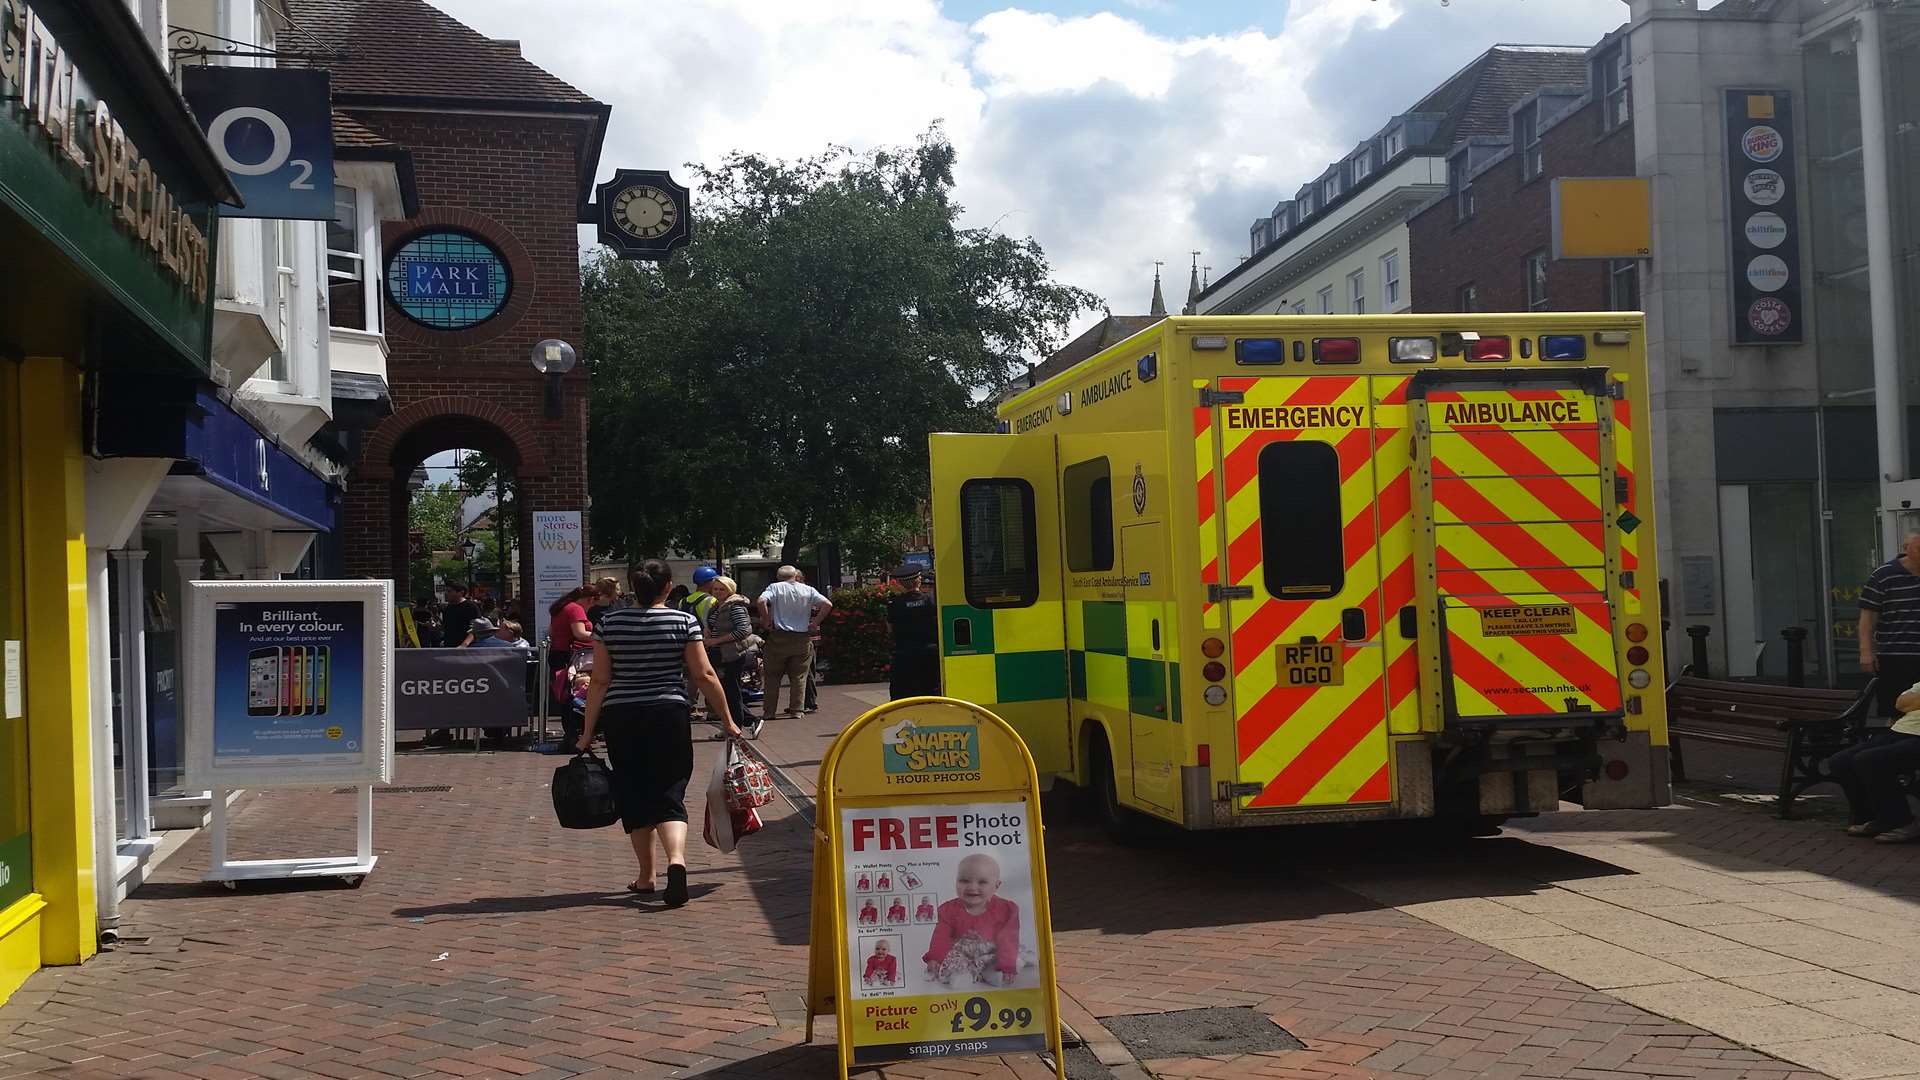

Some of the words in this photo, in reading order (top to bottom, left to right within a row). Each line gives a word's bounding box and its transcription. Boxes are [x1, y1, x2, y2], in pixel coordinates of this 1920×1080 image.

[1748, 138, 1778, 153] KING
[94, 99, 209, 304] SPECIALISTS
[415, 265, 480, 281] PARK
[414, 281, 484, 296] MALL
[1016, 404, 1054, 433] EMERGENCY
[1080, 369, 1132, 408] AMBULANCE
[1227, 406, 1365, 429] EMERGENCY
[1444, 401, 1582, 424] AMBULANCE
[543, 520, 579, 530] stores
[537, 529, 564, 541] this
[538, 540, 579, 554] way
[262, 610, 322, 621] Brilliant.
[1483, 608, 1521, 619] KEEP
[1523, 607, 1571, 617] CLEAR
[240, 621, 253, 632] In
[256, 623, 296, 635] every
[299, 621, 344, 632] colour.
[400, 677, 490, 696] GREGGS
[1483, 684, 1592, 695] www.secamb.nhs.uk
[895, 729, 972, 756] SNAPPY
[906, 751, 970, 771] SNAPS
[886, 775, 891, 784] 1
[895, 774, 931, 784] HOUR
[934, 772, 981, 783] PHOTOS
[963, 813, 1021, 830] Photo
[852, 816, 959, 852] FREE
[964, 830, 1022, 847] Shoot
[865, 1005, 918, 1018] Picture
[929, 999, 960, 1015] Only
[950, 996, 1033, 1033] £9.99
[875, 1018, 910, 1032] Pack
[908, 1042, 951, 1057] snappy
[954, 1040, 988, 1054] snaps
